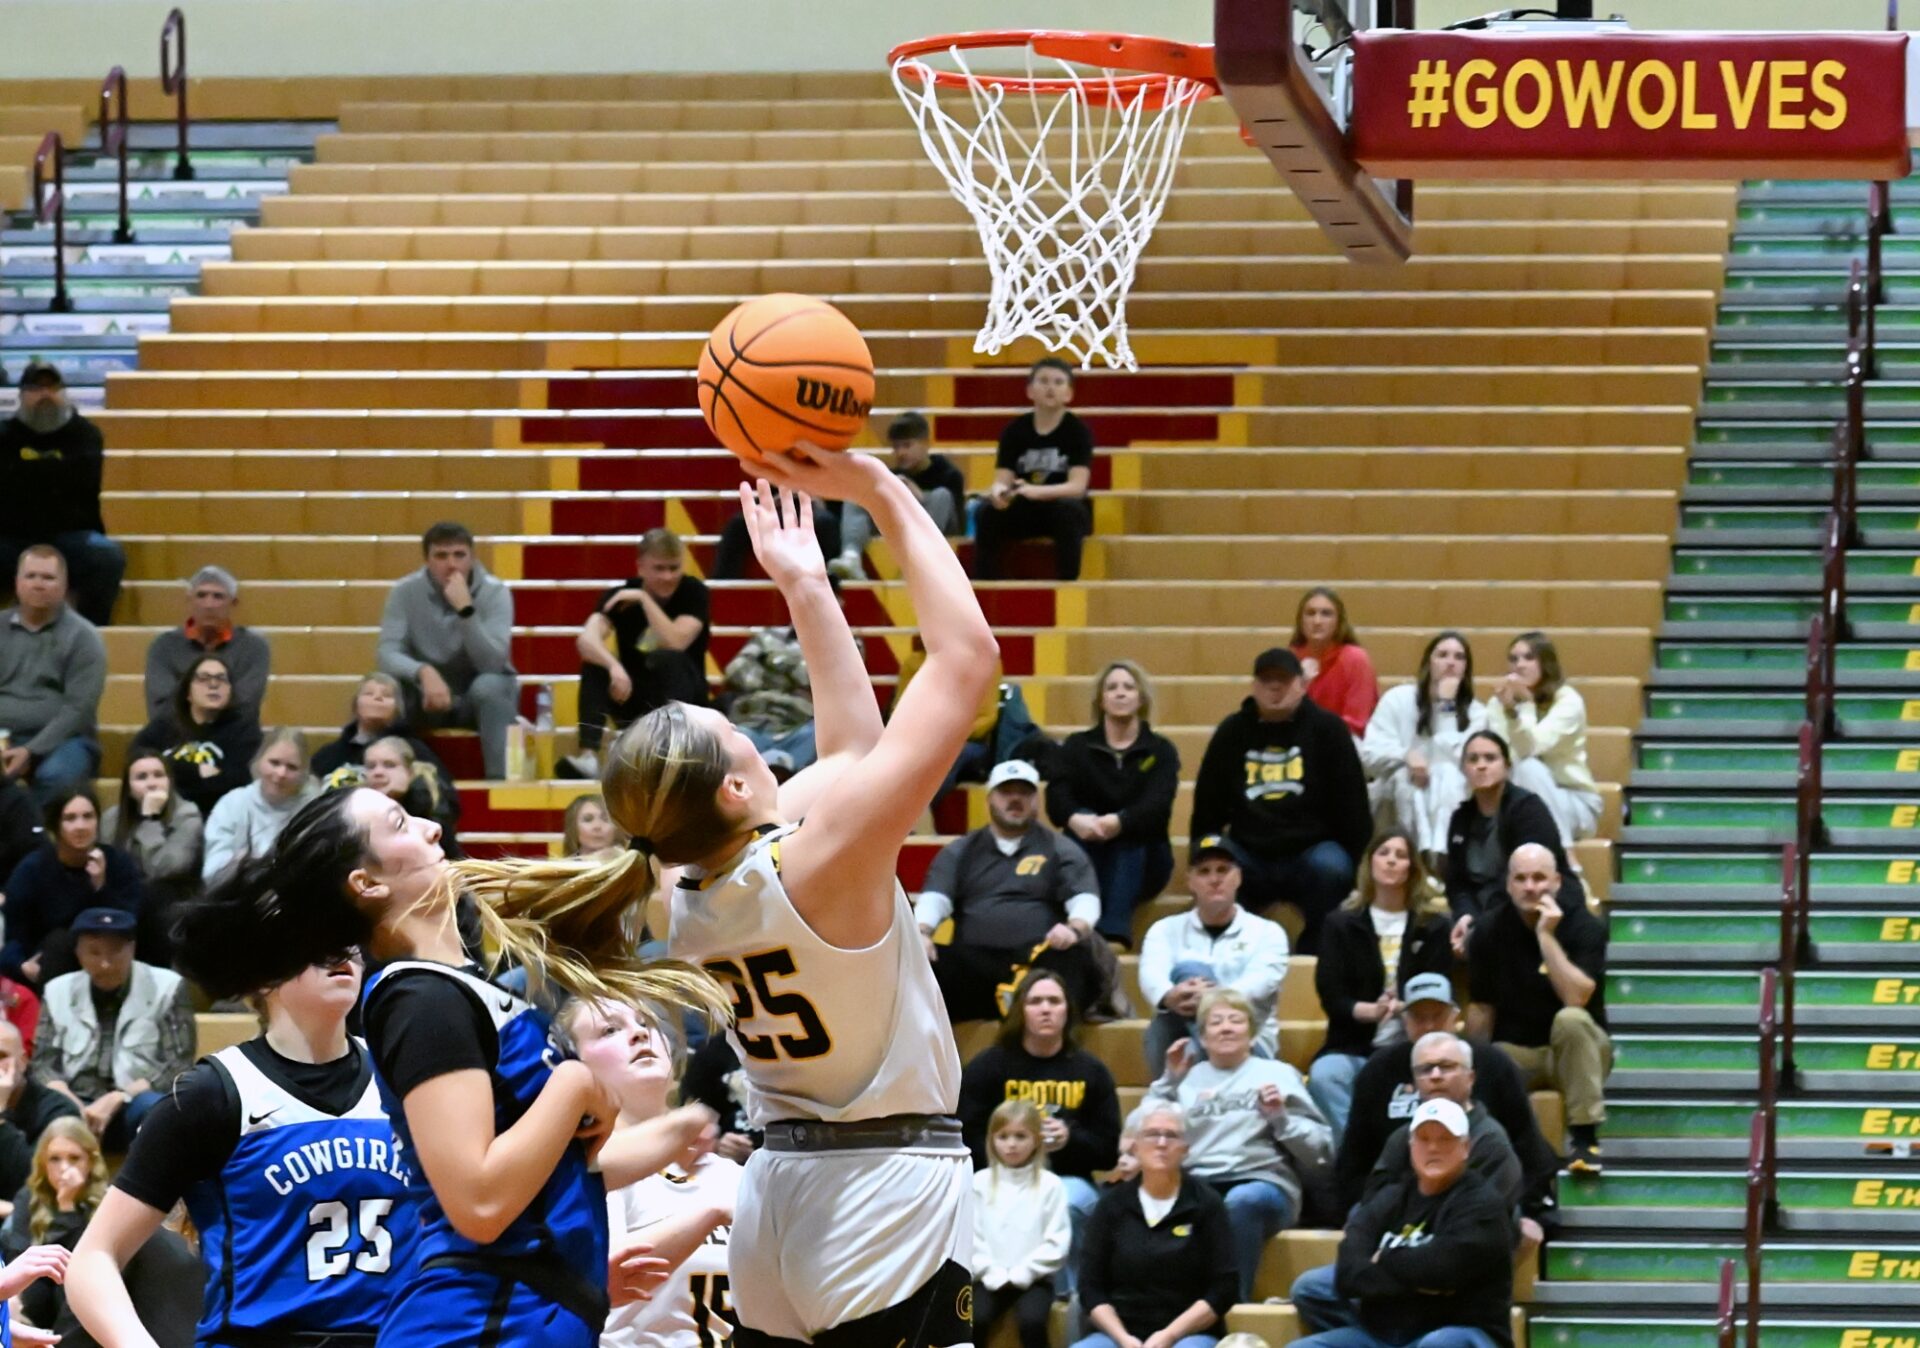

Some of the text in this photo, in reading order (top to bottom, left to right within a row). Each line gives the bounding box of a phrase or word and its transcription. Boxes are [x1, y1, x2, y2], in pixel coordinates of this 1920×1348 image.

[1407, 58, 1848, 131] #GOWOLVES
[702, 944, 833, 1061] 25
[306, 1197, 393, 1281] 25
